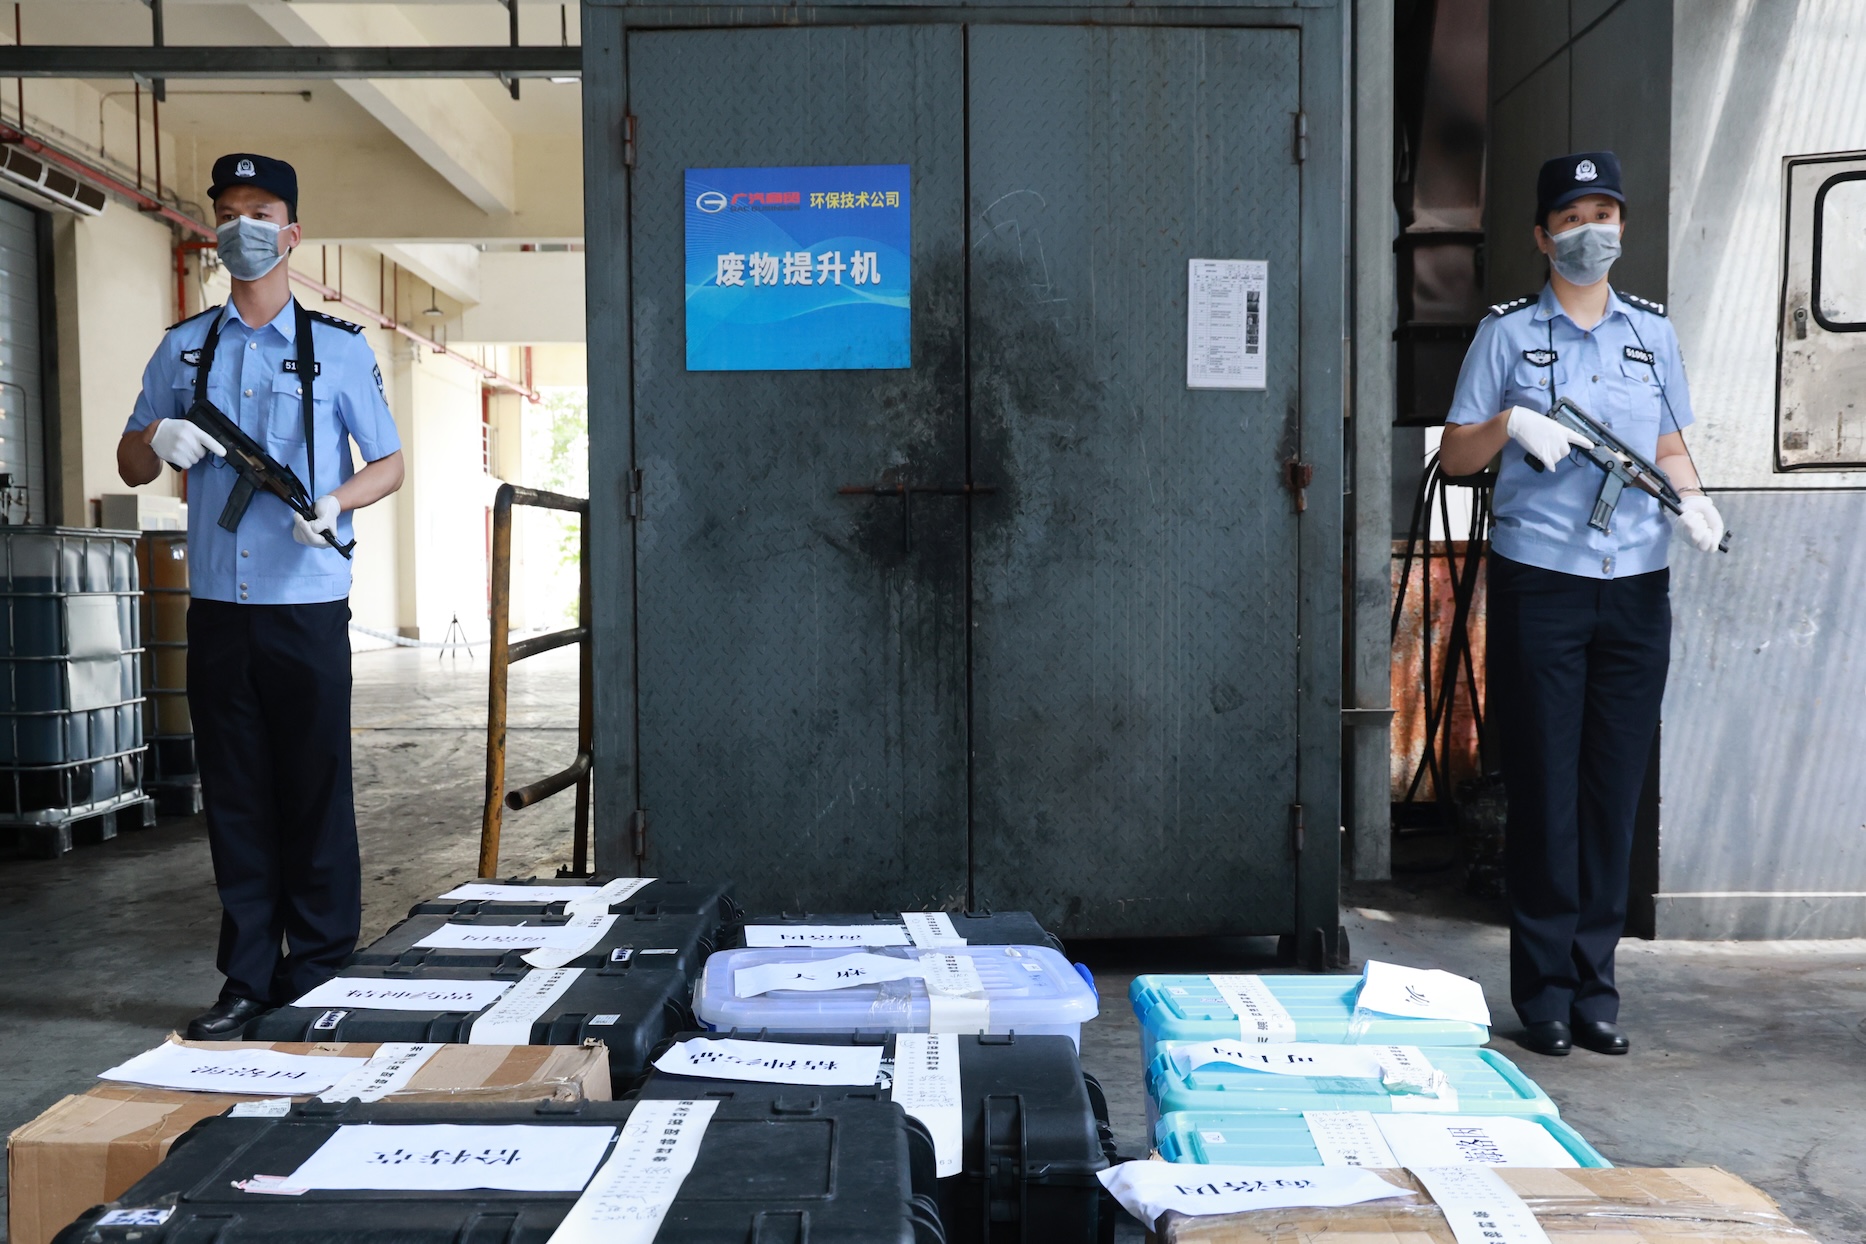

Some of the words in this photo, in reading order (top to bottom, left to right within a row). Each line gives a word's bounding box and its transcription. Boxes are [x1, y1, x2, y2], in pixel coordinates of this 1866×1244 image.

[810, 191, 900, 209] 环保技术公司
[715, 250, 881, 287] 废物提升机
